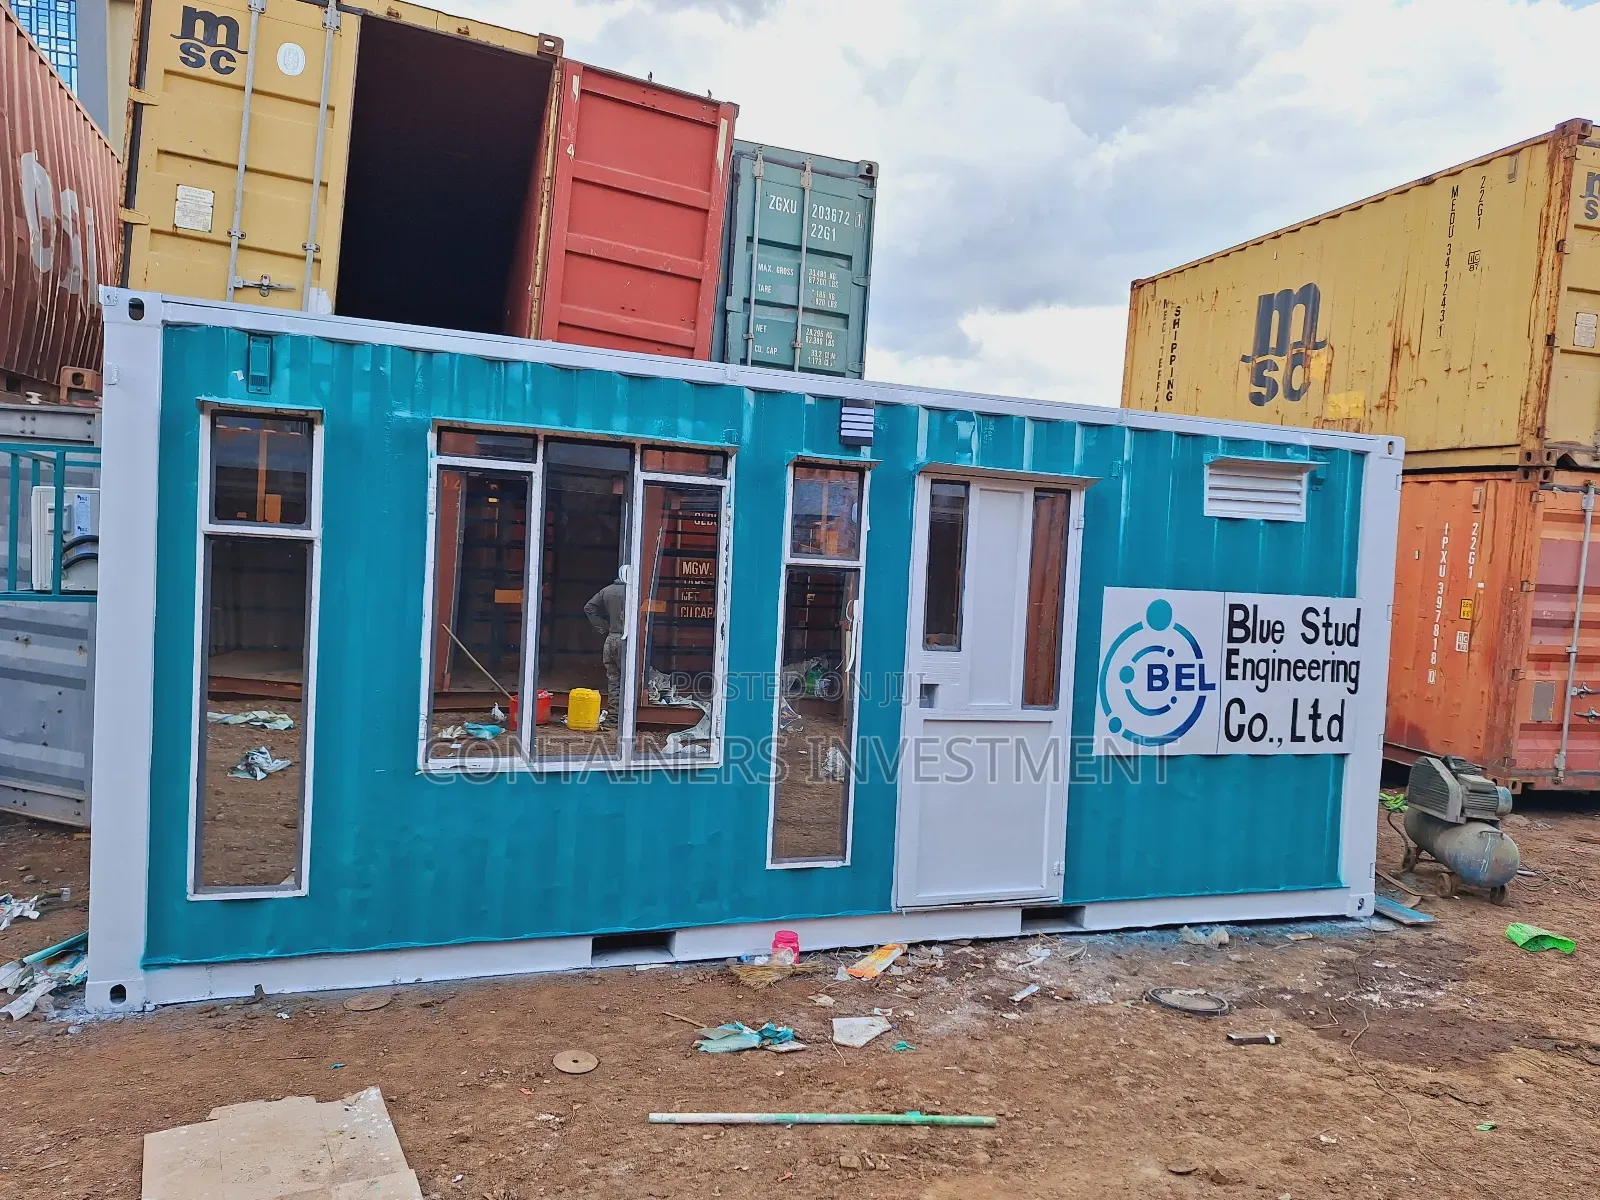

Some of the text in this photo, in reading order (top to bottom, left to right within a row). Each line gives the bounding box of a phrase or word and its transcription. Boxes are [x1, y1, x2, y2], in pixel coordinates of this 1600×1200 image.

[769, 195, 797, 214] ZGXU
[812, 204, 850, 226] 203672
[1448, 185, 1459, 238] MEDU
[1477, 175, 1486, 230] 22G1
[811, 223, 836, 241] 22G1
[758, 263, 794, 276] MAX. GROSS
[758, 284, 772, 293] TARE
[1440, 243, 1452, 322] 341243
[756, 324, 767, 333] NET
[1166, 305, 1181, 401] SHIPPING
[682, 561, 713, 576] MGW.
[1438, 522, 1449, 577] IPXU
[1468, 522, 1479, 579] 22G1
[1227, 603, 1362, 648] Blue Stud
[1430, 582, 1444, 665] 397818
[1147, 663, 1216, 692] BEL
[1225, 648, 1361, 695] Engineering
